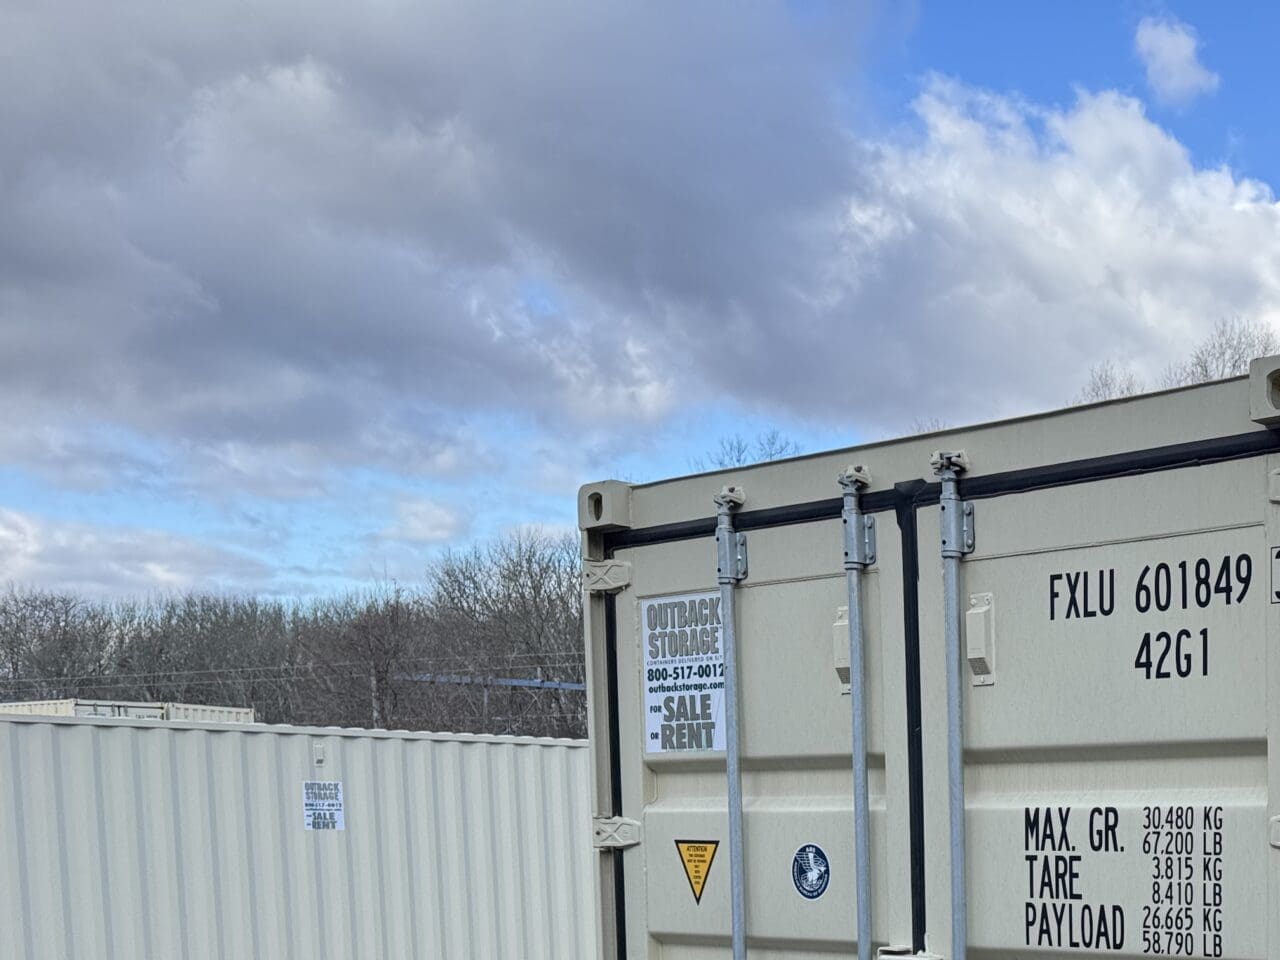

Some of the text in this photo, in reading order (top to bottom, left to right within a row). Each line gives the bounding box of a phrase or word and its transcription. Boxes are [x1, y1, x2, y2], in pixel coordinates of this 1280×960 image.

[1050, 568, 1115, 620] FXLU
[1135, 553, 1252, 613] 601849
[647, 597, 721, 631] OUTBACK
[648, 627, 719, 660] STORAGE
[1135, 628, 1208, 679] 42G1
[647, 663, 724, 681] 800-517-0012
[648, 681, 724, 693] outbackstorage.com
[650, 694, 711, 722] FOR SALE
[650, 722, 715, 750] OR RENT
[1025, 806, 1223, 852] MAX. GR. 30,480 KG
[1142, 831, 1222, 856] 67,200 LB
[1025, 855, 1223, 900] TARE 3,815 KG
[1152, 881, 1222, 907] 8,410 LB
[1025, 902, 1223, 950] PAYLOAD 26,665 KG
[1142, 931, 1222, 958] 58,790 LB
